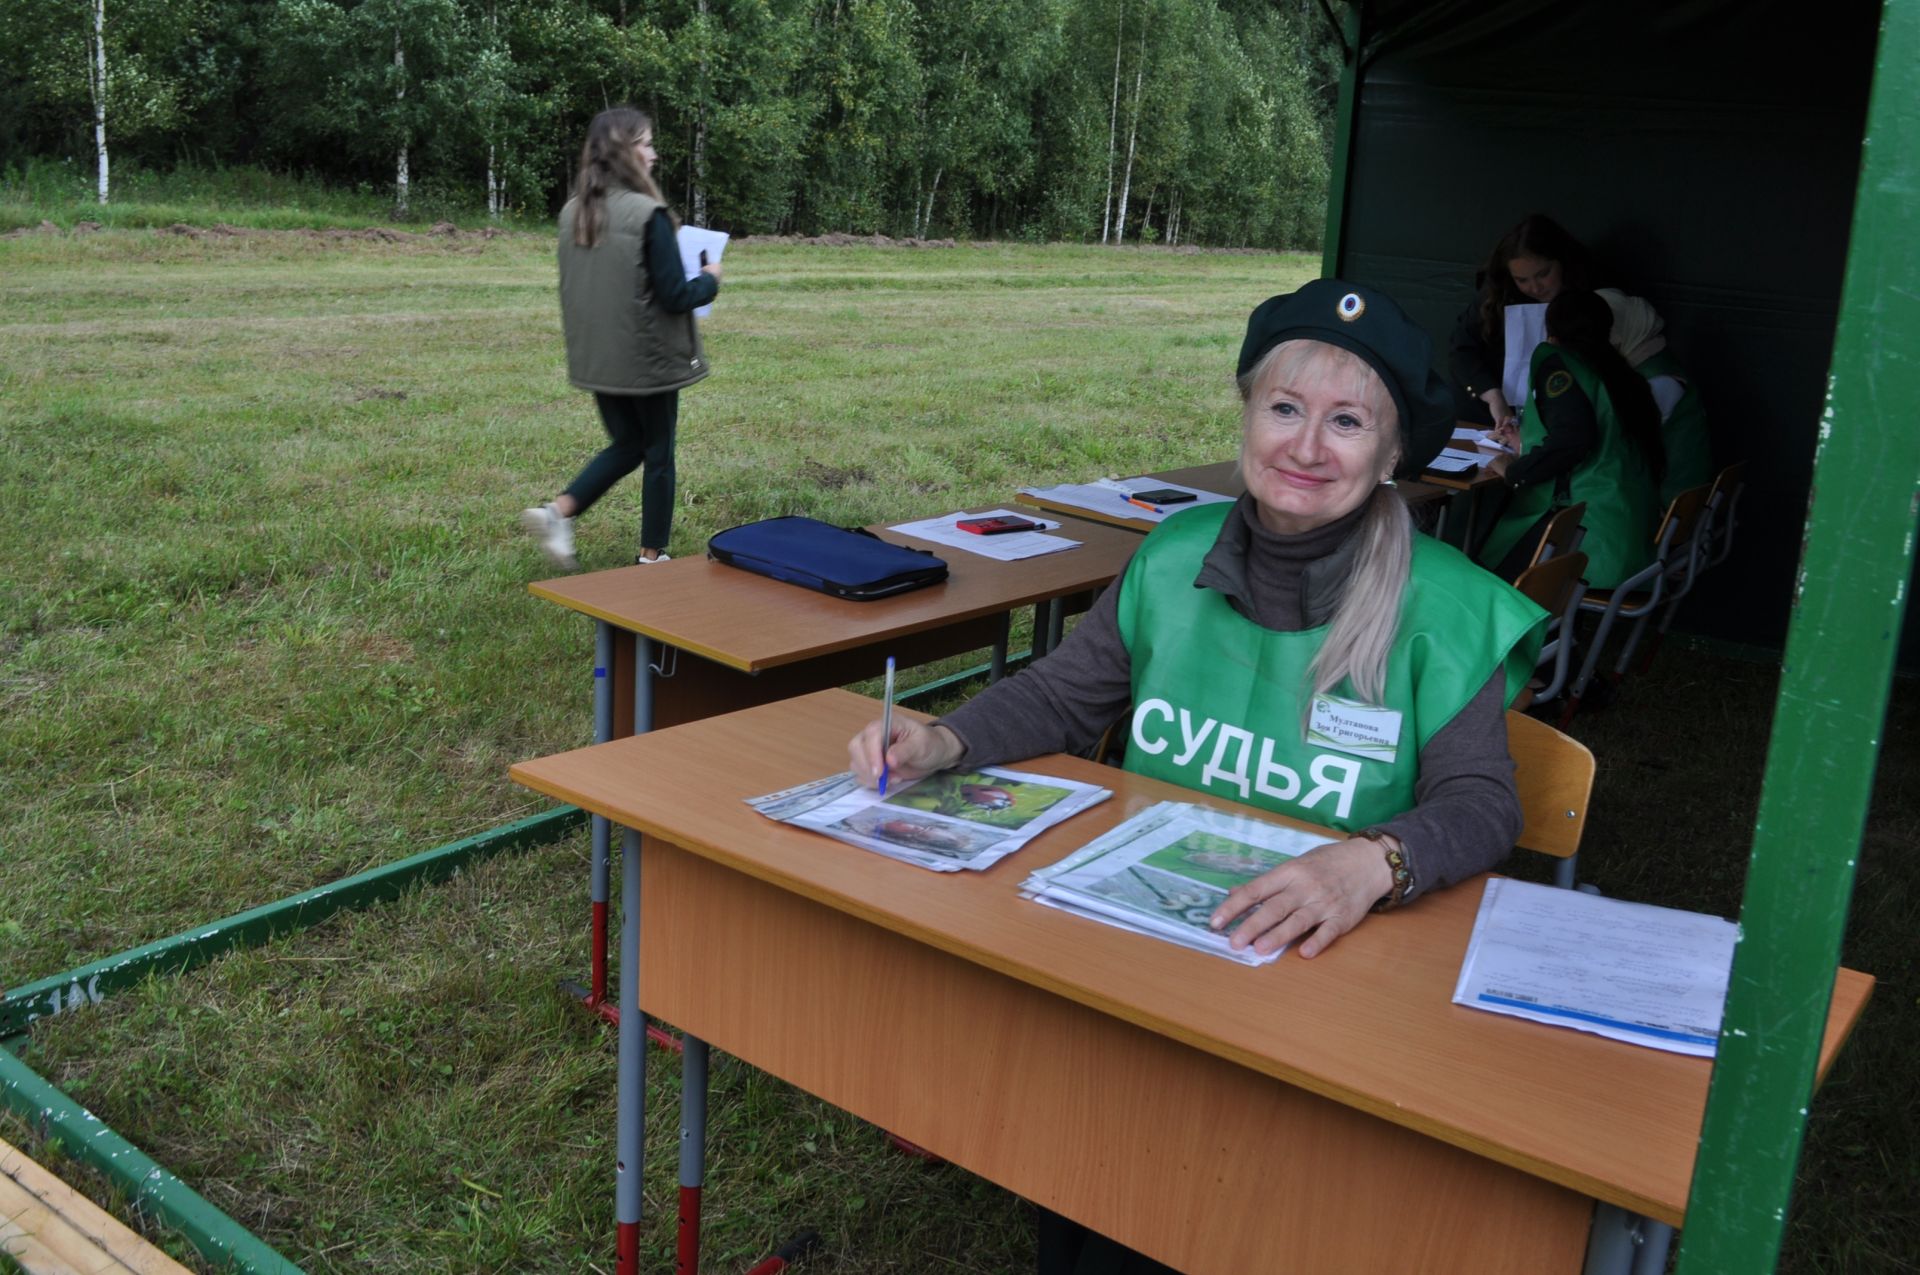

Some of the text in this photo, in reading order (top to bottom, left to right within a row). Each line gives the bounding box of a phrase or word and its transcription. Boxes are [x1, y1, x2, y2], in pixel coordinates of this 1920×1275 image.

[1131, 698, 1362, 819] СУДЬЯ
[1315, 721, 1391, 745] Зоя Григорьевна
